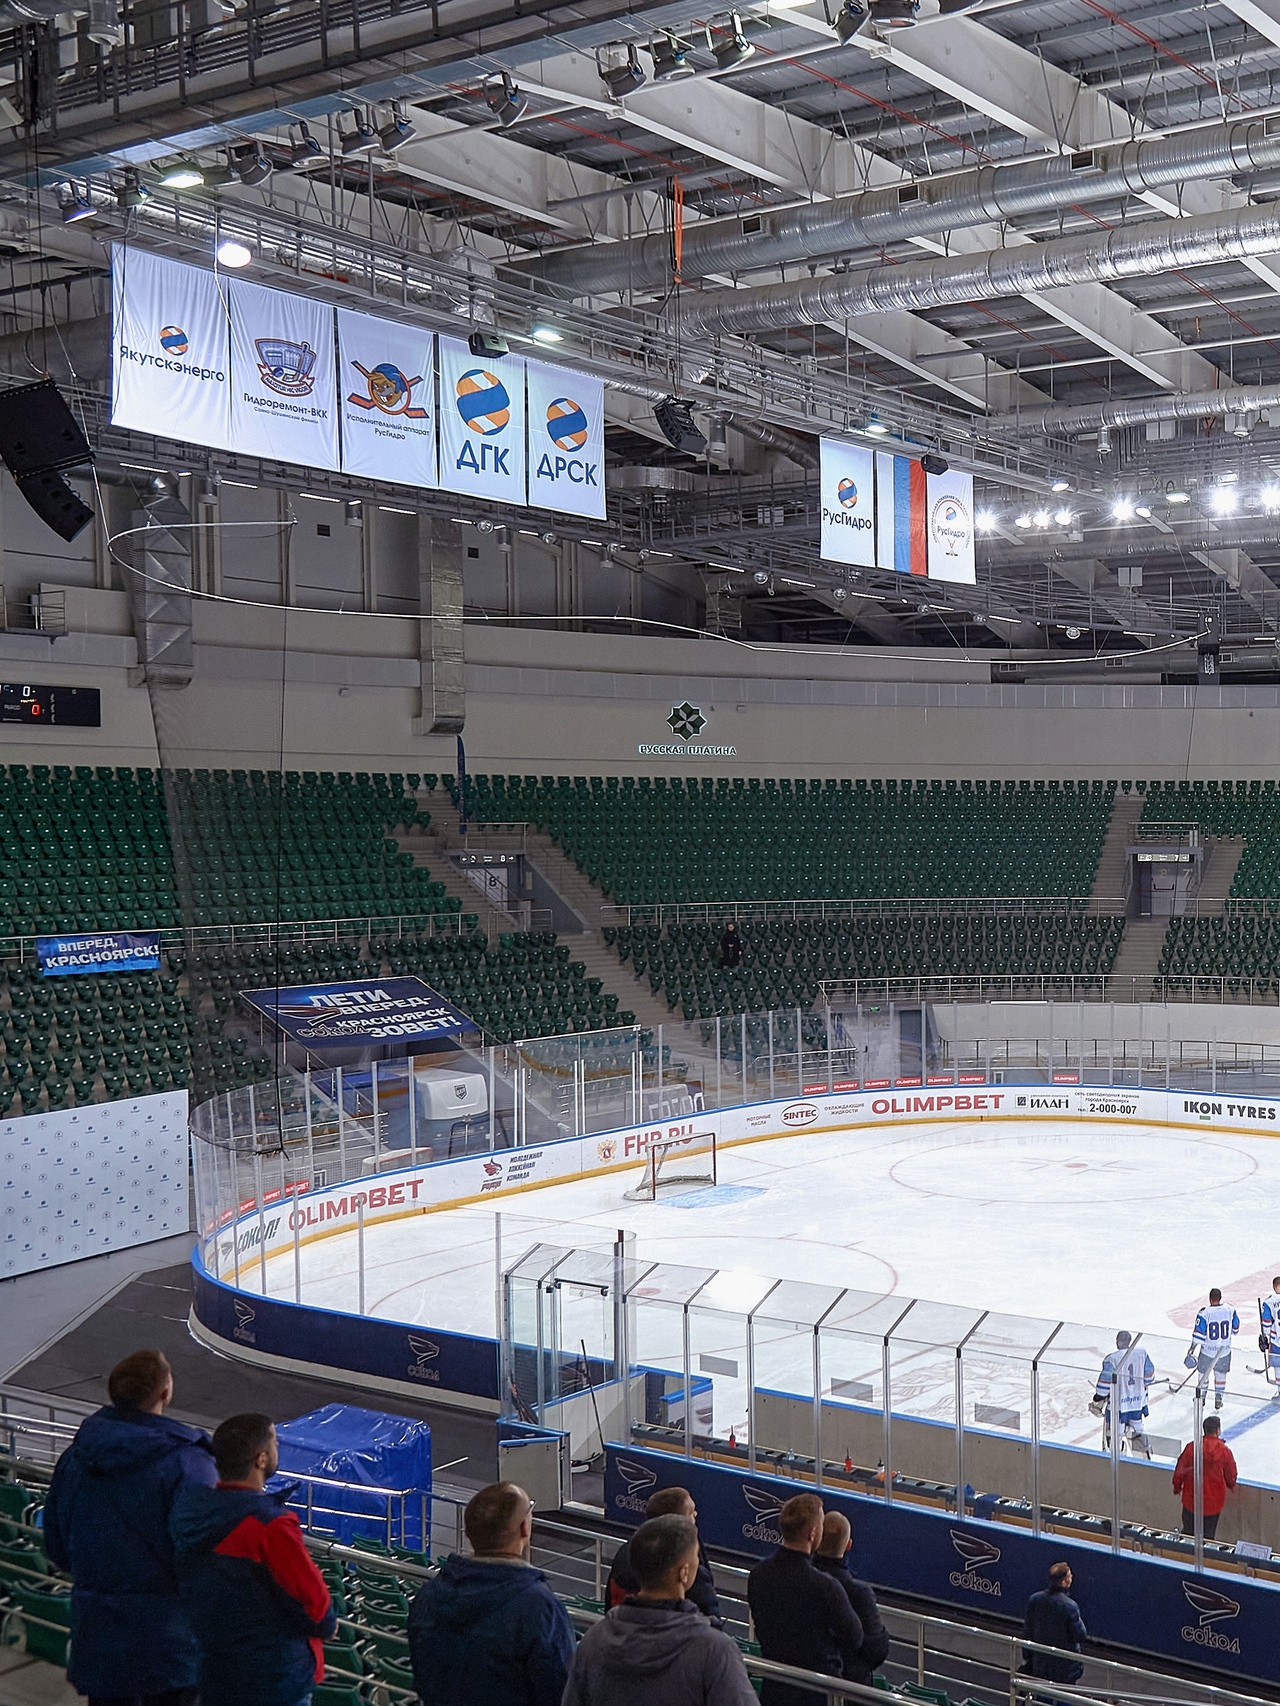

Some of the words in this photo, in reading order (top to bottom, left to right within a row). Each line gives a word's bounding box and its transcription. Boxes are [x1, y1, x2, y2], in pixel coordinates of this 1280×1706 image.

[120, 345, 225, 382] Якутскэнерго
[243, 393, 328, 419] Гидроремонт-ВКК
[346, 412, 403, 432] Исполнительный
[403, 424, 430, 437] аппарат
[374, 428, 406, 441] РусГидро
[456, 440, 510, 476] ДГК
[536, 453, 598, 487] ДРСК
[822, 508, 872, 531] РусГидро
[639, 744, 685, 754] РУССКАЯ
[687, 746, 737, 756] ПЛАТИНА
[58, 937, 118, 952] ВПЕРЕД,
[46, 944, 160, 968] КРАСНОЯРСК!
[309, 989, 392, 1007] ЛЕТИ
[340, 996, 432, 1015] ВПЕРЕД-
[335, 1007, 451, 1028] КРАСНОЯРСК
[369, 1015, 462, 1038] ЗОВЕТ!
[804, 1085, 828, 1094] OLIMPBET
[834, 1083, 858, 1091] OLIMPBET
[864, 1080, 890, 1088] OLIMPBET
[896, 1078, 922, 1086] OLIMPBET
[824, 1102, 865, 1111] ОХЛАЖДАЮЩИЕ
[830, 1108, 859, 1116] ЖИДКОСТИ
[872, 1094, 1005, 1115] OLIMPBET
[1030, 1098, 1069, 1109] ИЛАН
[1089, 1103, 1137, 1115] 2-000-007
[1184, 1100, 1222, 1115] IKON
[1227, 1104, 1277, 1120] TYRES
[783, 1109, 817, 1120] SINTEC
[288, 1179, 424, 1231] OLIMPBET
[1208, 1320, 1230, 1341] 80
[1126, 1363, 1135, 1386] 1
